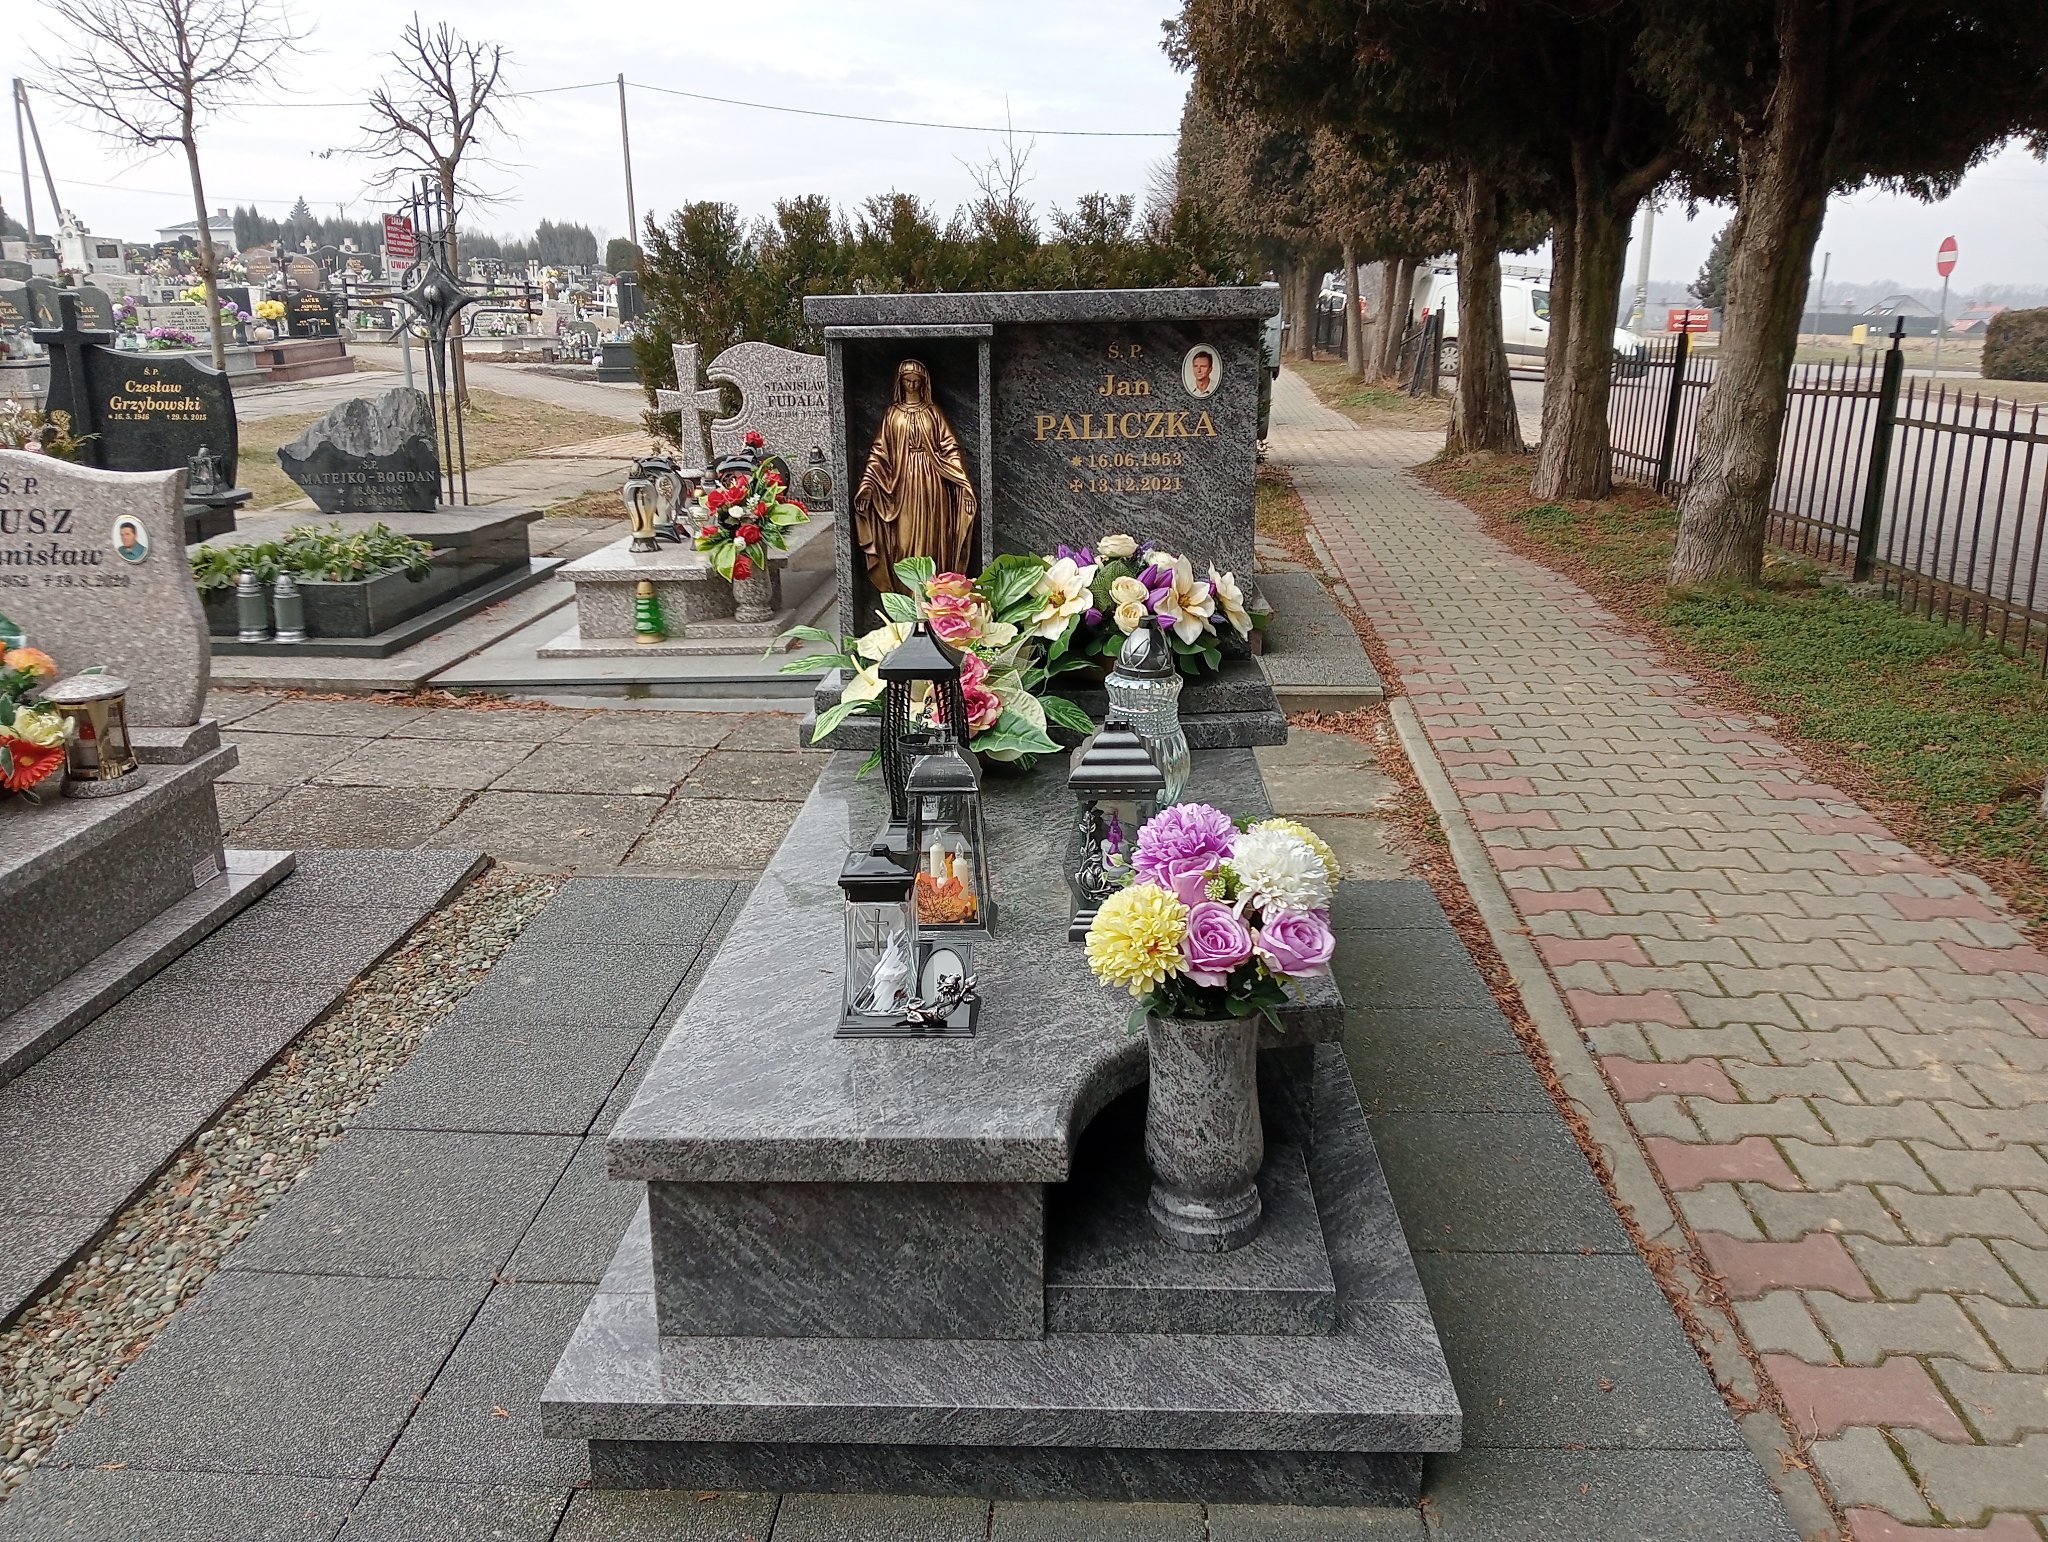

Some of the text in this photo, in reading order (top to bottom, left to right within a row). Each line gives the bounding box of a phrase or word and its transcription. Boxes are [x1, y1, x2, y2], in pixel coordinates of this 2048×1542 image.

[391, 260, 413, 270] UWAG
[1129, 343, 1144, 359] P.
[124, 379, 182, 394] Czesław
[1098, 374, 1151, 398] Jan
[109, 395, 201, 414] Grzybowski
[1034, 410, 1218, 441] PALICZKA
[1088, 451, 1183, 468] 16.06.1953
[24, 477, 39, 495] P.
[1088, 476, 1182, 493] 13.12.2021
